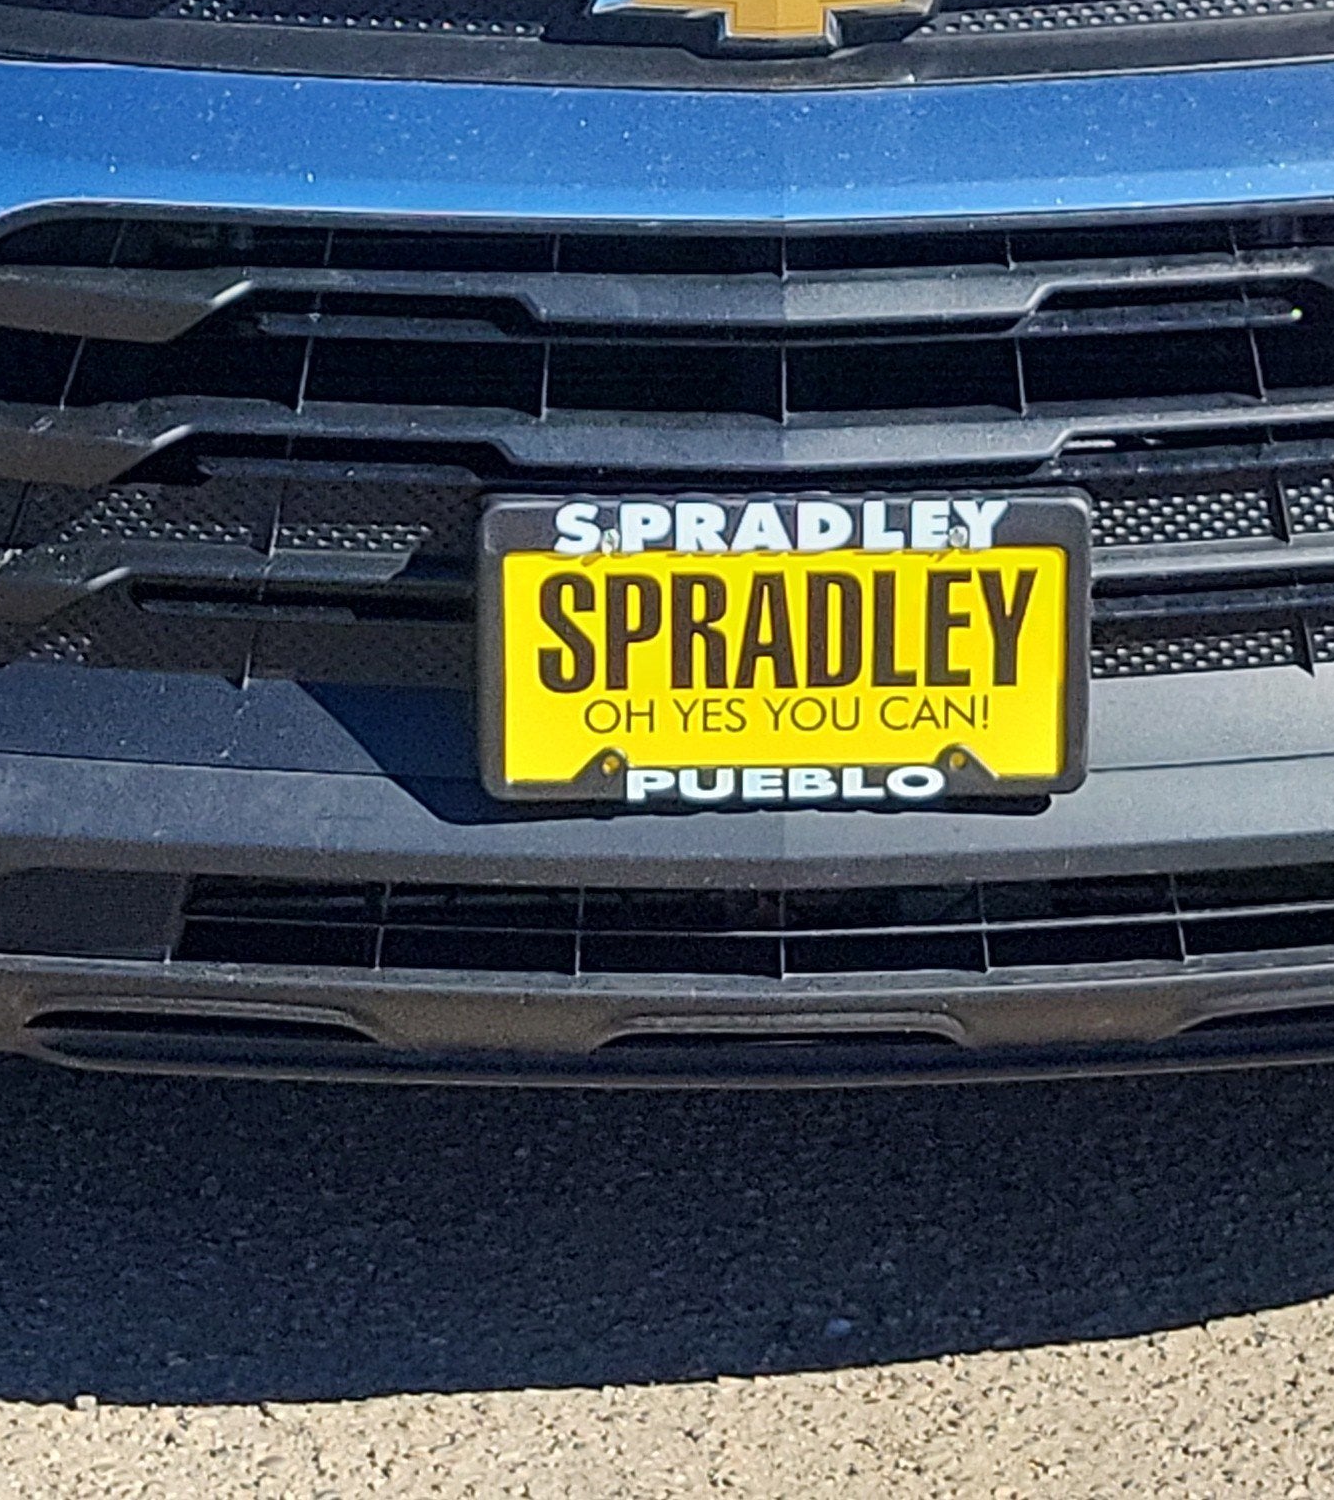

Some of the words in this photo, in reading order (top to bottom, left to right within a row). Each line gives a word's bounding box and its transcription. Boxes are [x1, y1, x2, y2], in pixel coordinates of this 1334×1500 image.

[555, 501, 1008, 552] SPRADLEY
[537, 568, 1038, 694] SPRADLEY
[584, 699, 655, 734] OH
[673, 698, 746, 732] YES
[764, 697, 860, 731] YOU
[880, 696, 990, 730] CAN!
[627, 766, 945, 801] PUEBLO
